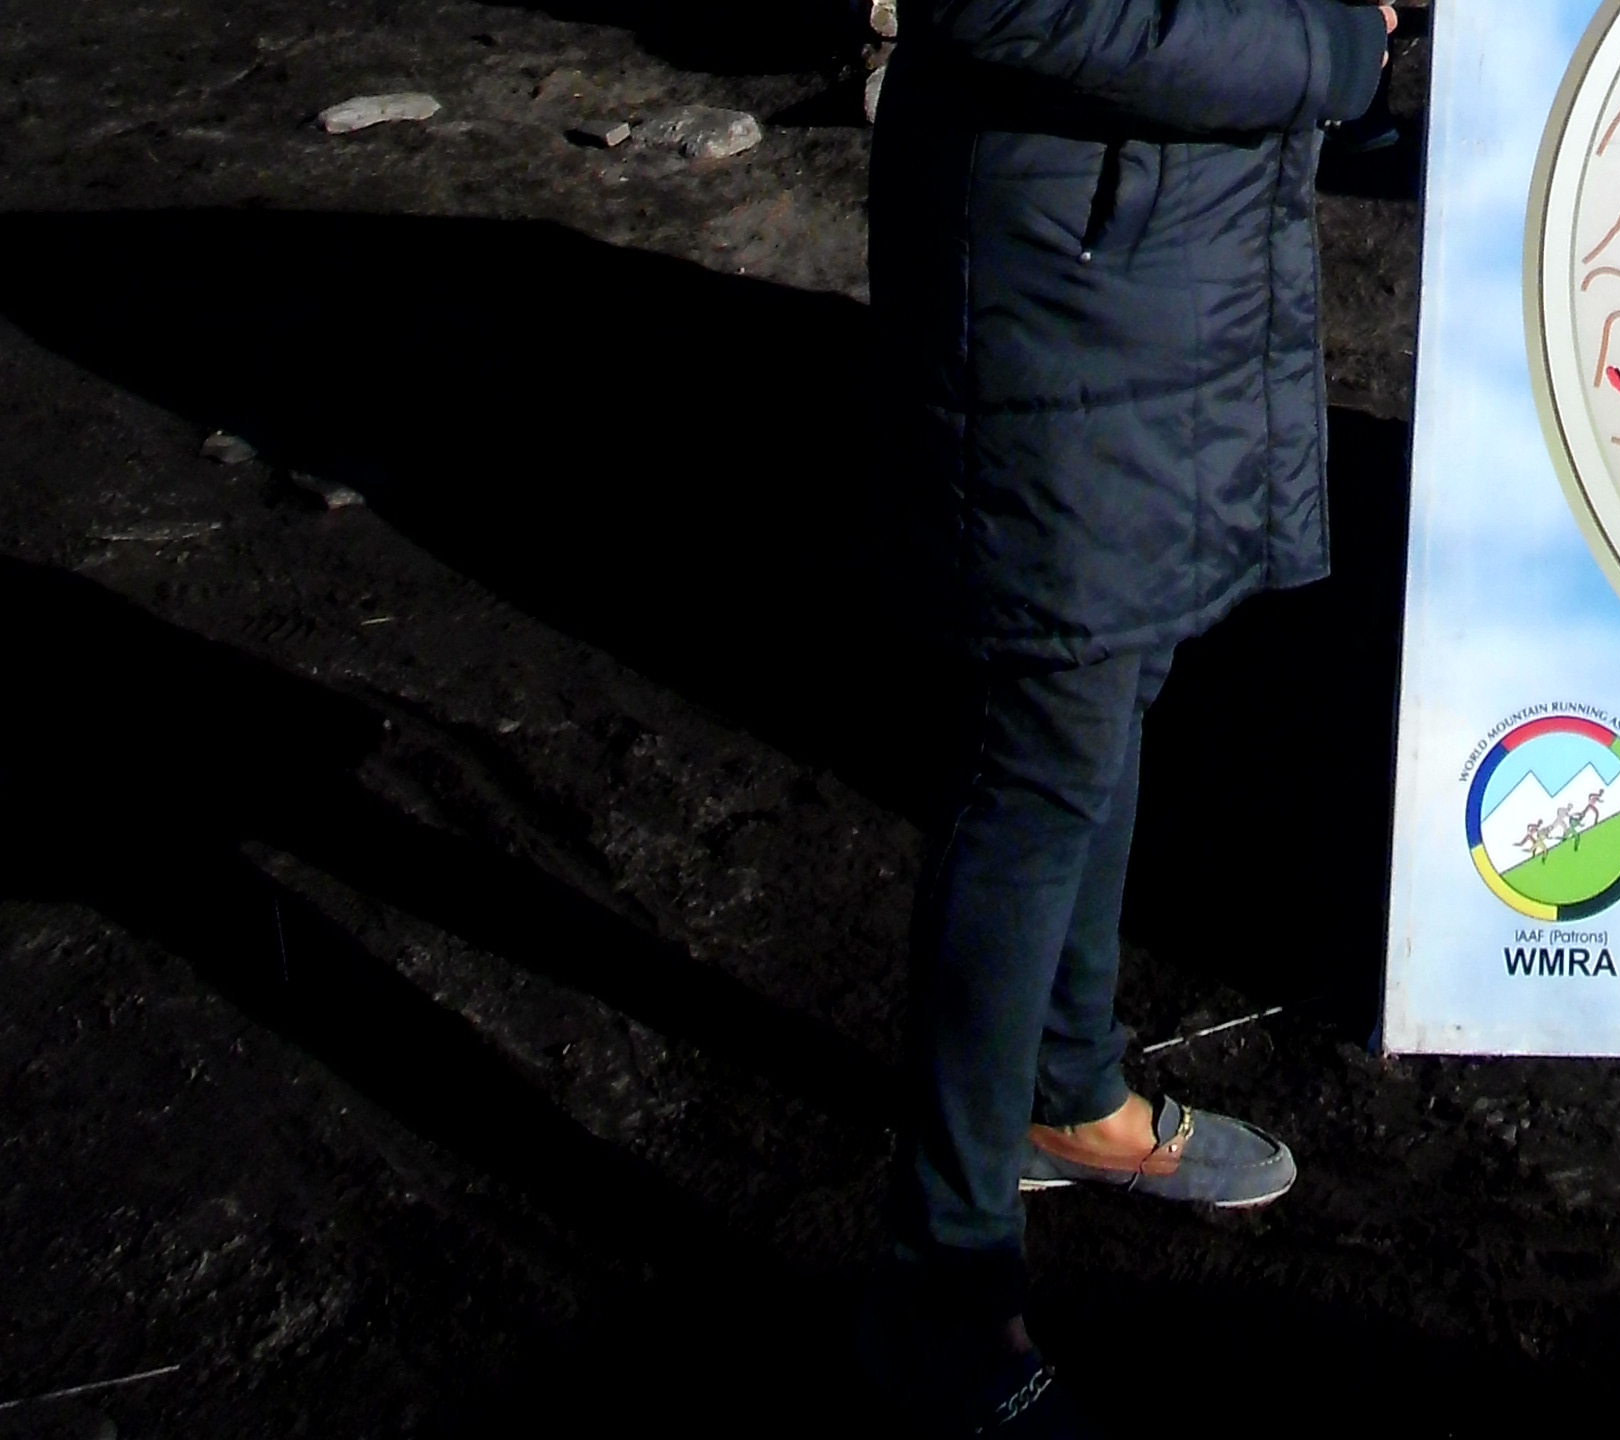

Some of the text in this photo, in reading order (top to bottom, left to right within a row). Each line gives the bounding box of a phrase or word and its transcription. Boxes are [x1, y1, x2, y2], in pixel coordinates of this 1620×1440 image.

[1459, 739, 1488, 782] WORLD
[1487, 703, 1549, 740] MOUNTAIN
[1551, 701, 1609, 722] RUNNING
[1515, 928, 1609, 947] IAAF (Patrons)
[1503, 946, 1618, 977] WMRA
